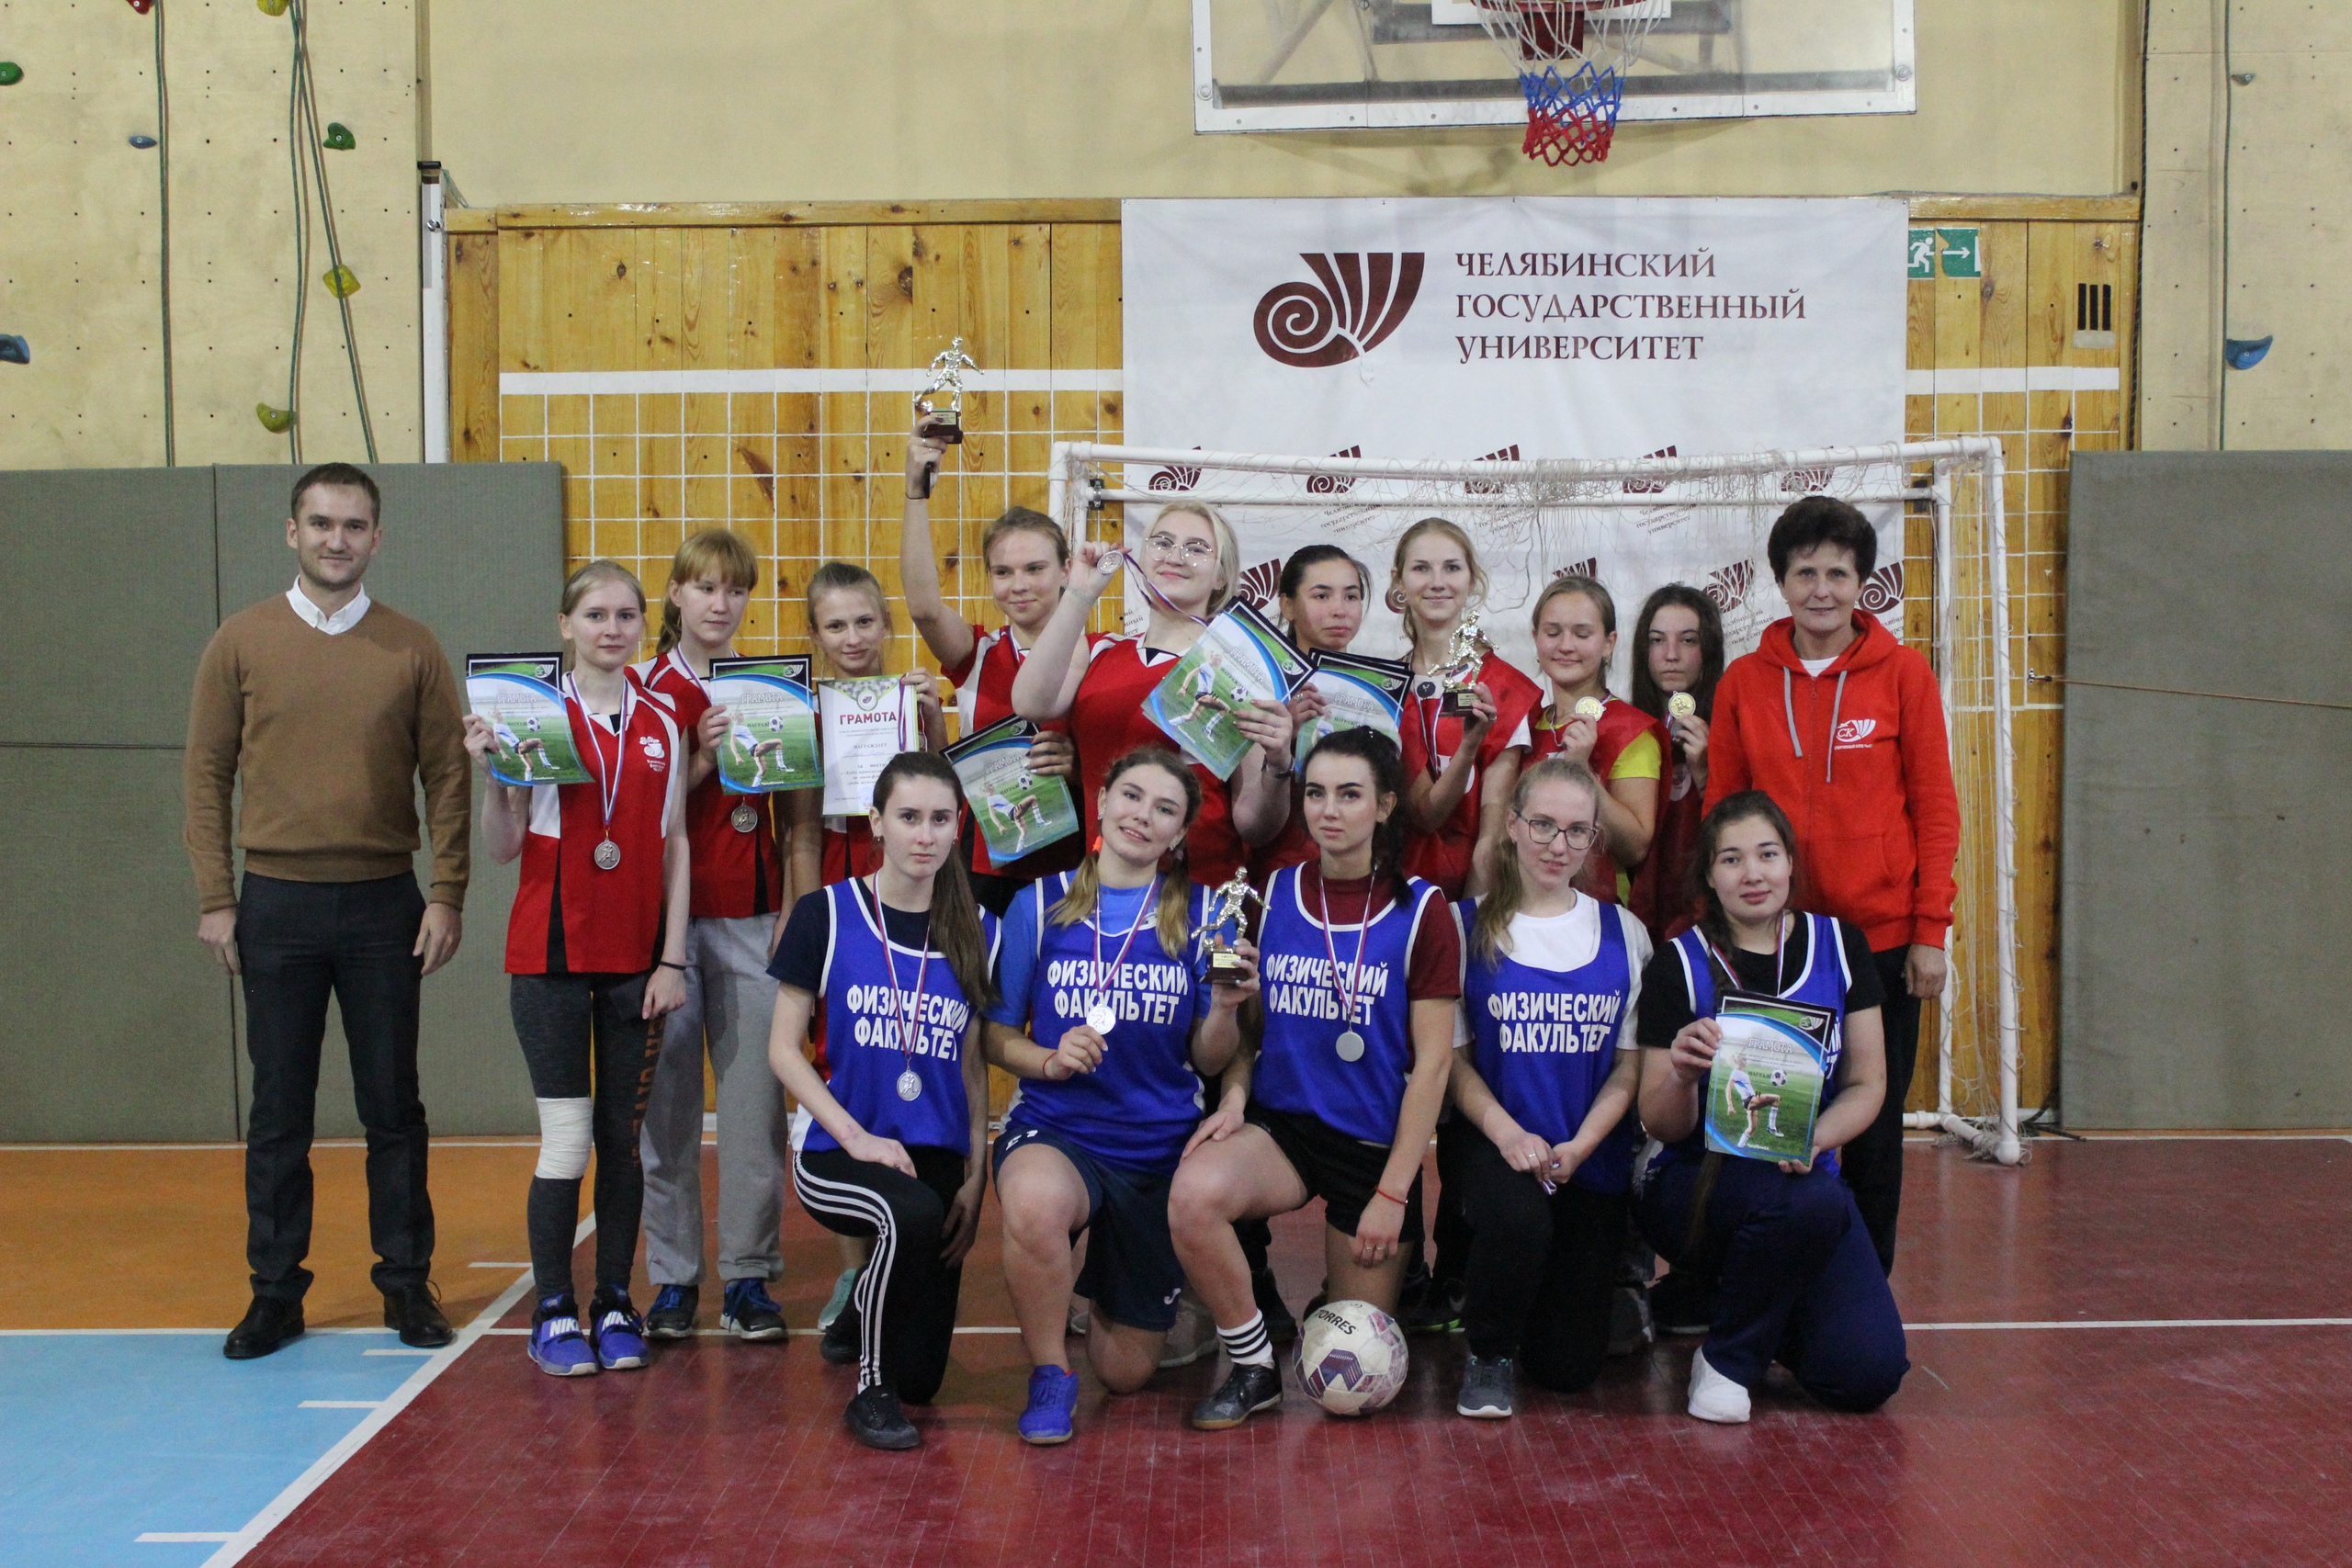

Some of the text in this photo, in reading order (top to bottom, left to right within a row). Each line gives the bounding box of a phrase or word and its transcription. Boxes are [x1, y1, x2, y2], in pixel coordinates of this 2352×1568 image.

[1455, 247, 1716, 277] ЧЕЛЯБИНСКИЙ
[1455, 288, 1806, 322] ГОСУДАРСТВЕННЫЙ
[1454, 335, 1704, 365] УНИВЕРСИТЕТ
[1231, 647, 1268, 683] ГРАМОТА
[497, 694, 537, 704] ГРАМОТА
[741, 693, 783, 704] ГРАМОТА
[1334, 693, 1374, 710] ГРАМОТА
[839, 711, 898, 726] ГРАМОТА
[984, 751, 1023, 774] ГРАМОТА
[1046, 960, 1189, 996] ФИЗИЧЕСКИЙ
[1266, 953, 1389, 998] ФИЗИЧЕСКИЙ
[1487, 989, 1621, 1024] ФИЗИЧЕСКИЙ
[1499, 1022, 1611, 1054] ФАКУЛЬТЕТ
[1747, 1037, 1793, 1054] ГРАМОТА
[1316, 1309, 1357, 1336] TORRES
